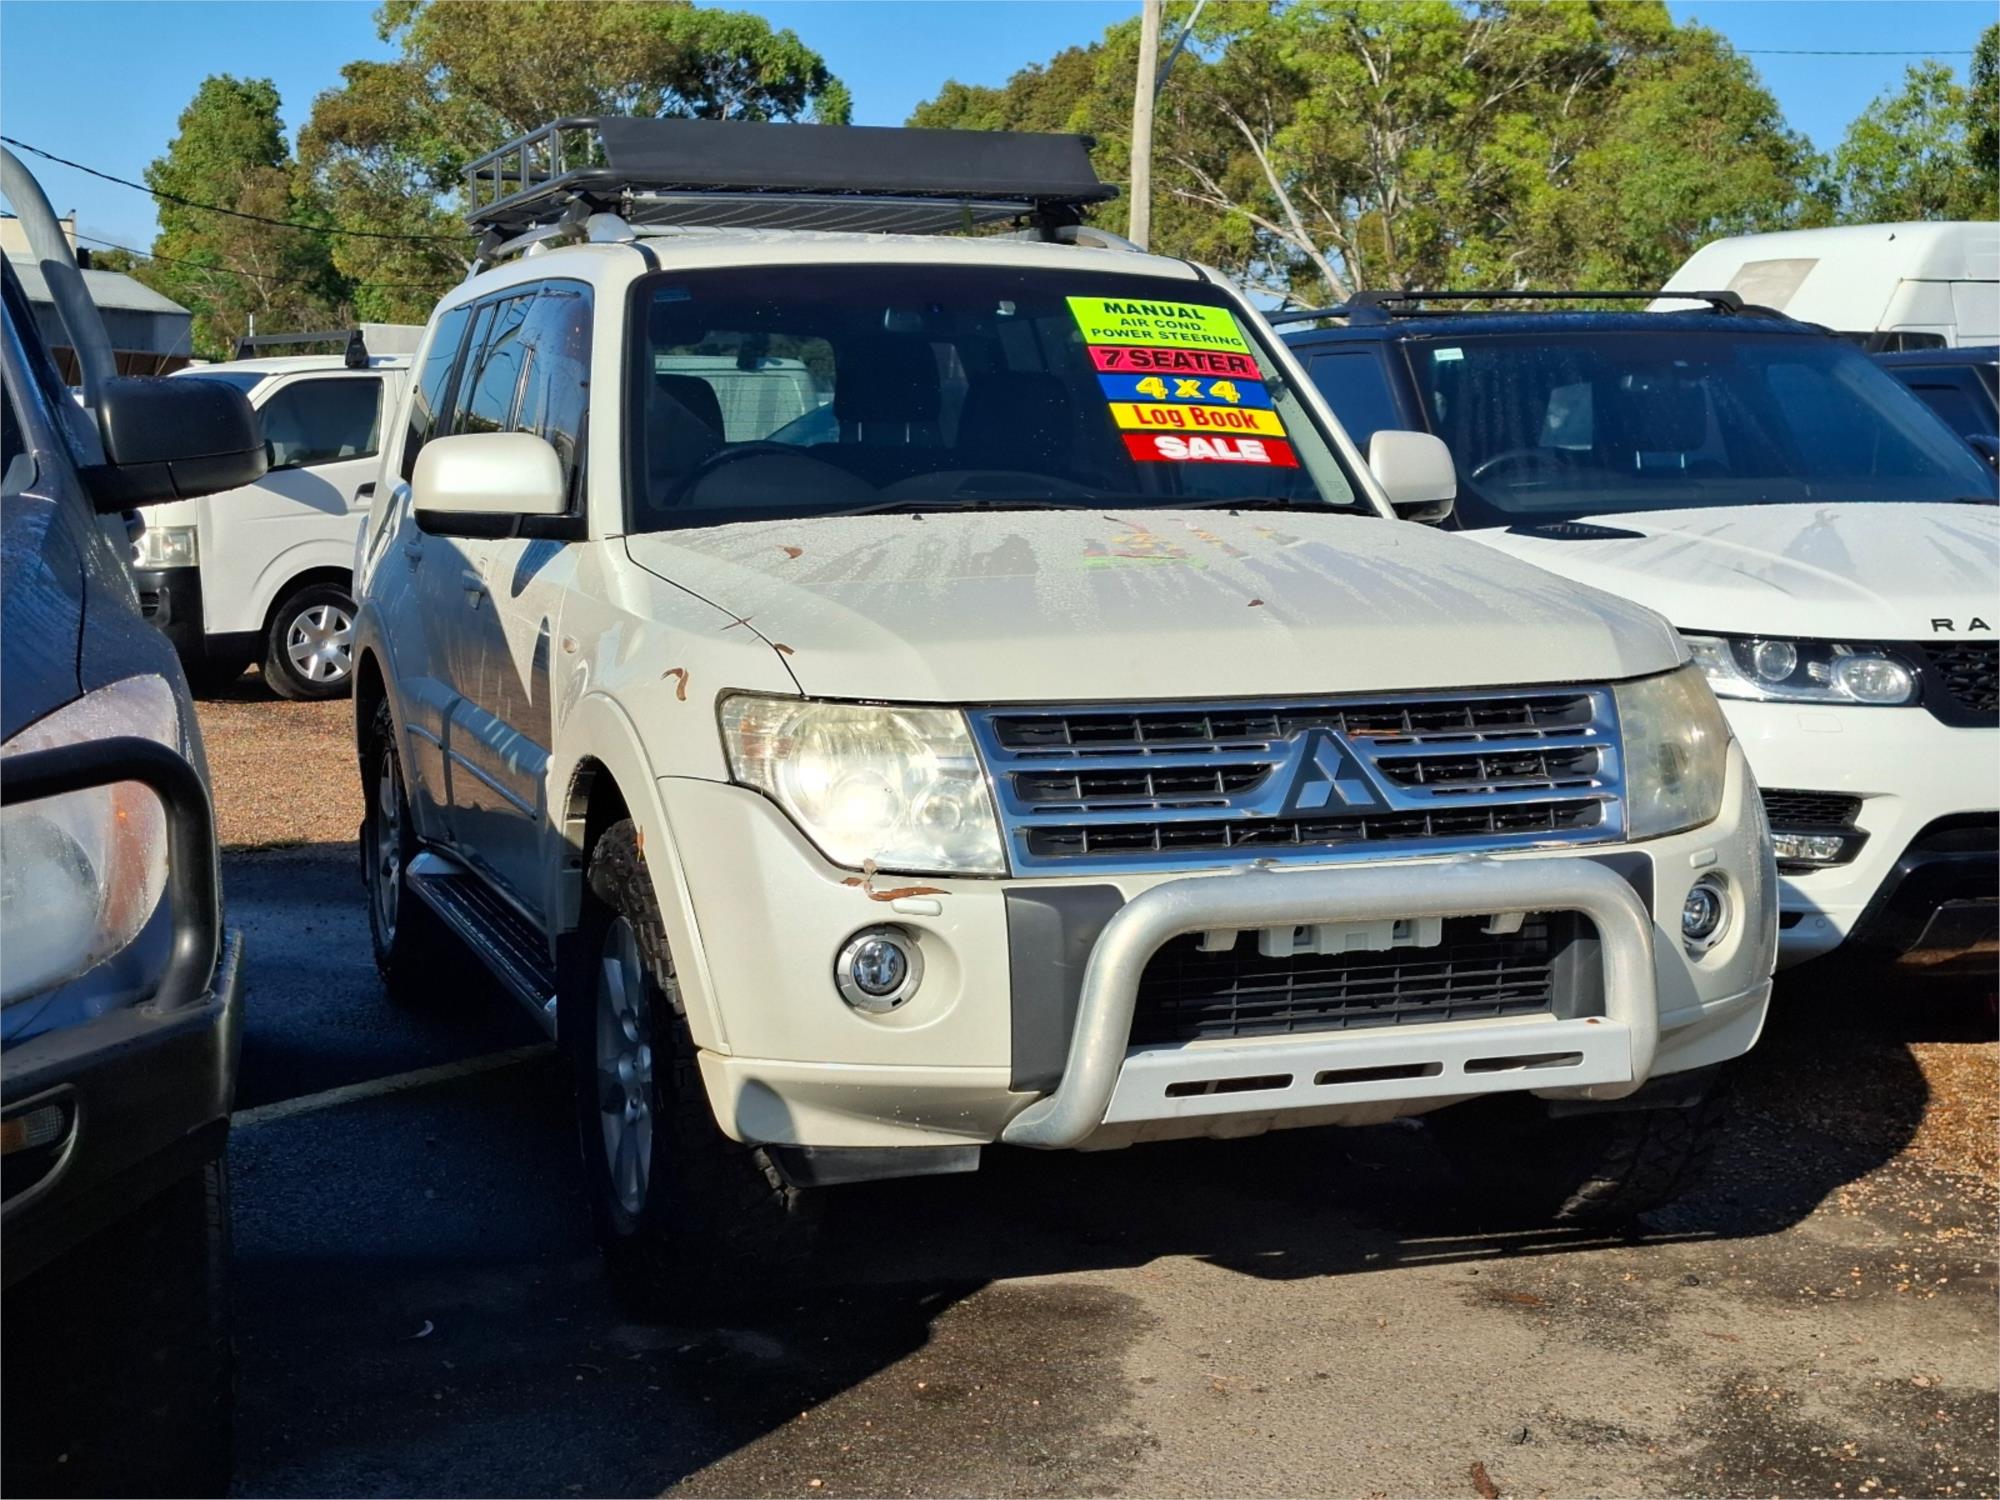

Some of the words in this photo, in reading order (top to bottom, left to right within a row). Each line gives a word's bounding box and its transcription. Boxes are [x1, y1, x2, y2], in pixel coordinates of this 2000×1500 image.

[1103, 302, 1206, 321] MANUAL
[1120, 317, 1149, 328] AIR
[1154, 320, 1207, 332] COND.
[1091, 328, 1153, 339] POWER
[1160, 331, 1242, 347] STEERING
[1100, 349, 1122, 367] 7
[1130, 350, 1248, 373] SEATER
[1133, 404, 1185, 427] Log
[1191, 407, 1260, 430] Book
[1154, 435, 1271, 463] SALE
